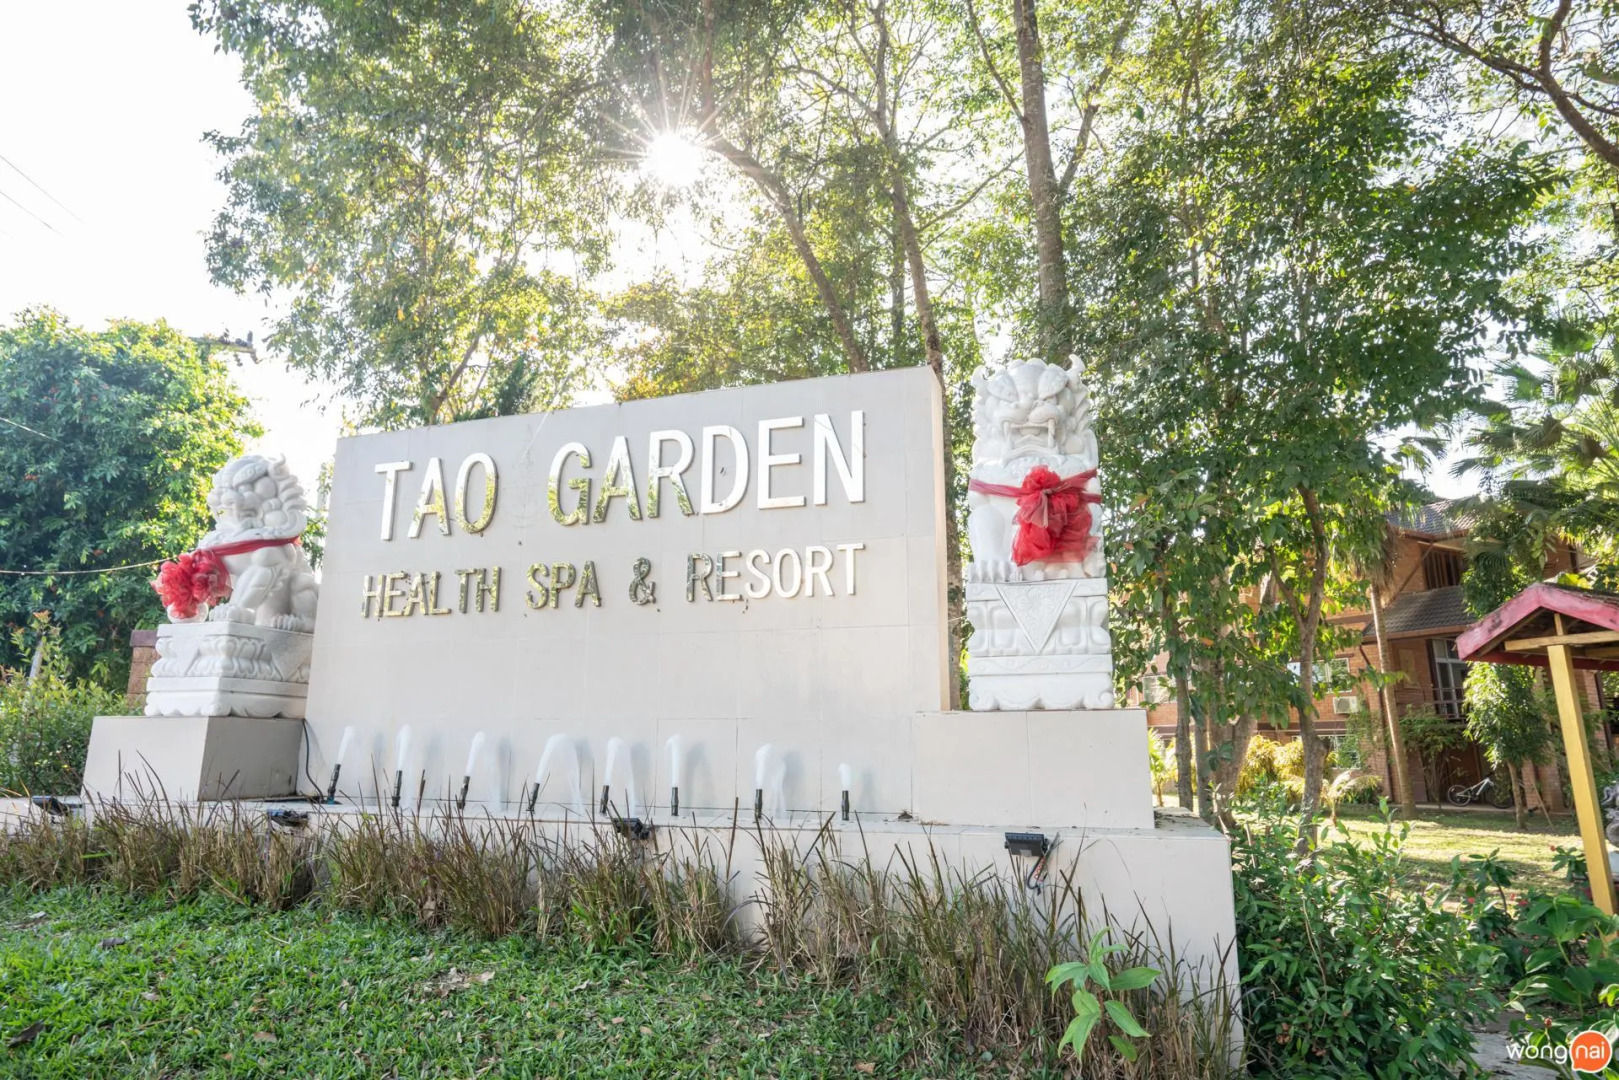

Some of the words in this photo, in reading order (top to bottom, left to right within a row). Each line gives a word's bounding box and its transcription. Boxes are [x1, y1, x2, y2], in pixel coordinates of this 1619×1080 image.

[375, 452, 499, 541] TAO
[548, 410, 865, 527] GARDEN
[361, 566, 502, 618] HEALTH
[526, 561, 602, 609] SPA
[628, 556, 657, 606] &
[685, 543, 865, 603] RESORT
